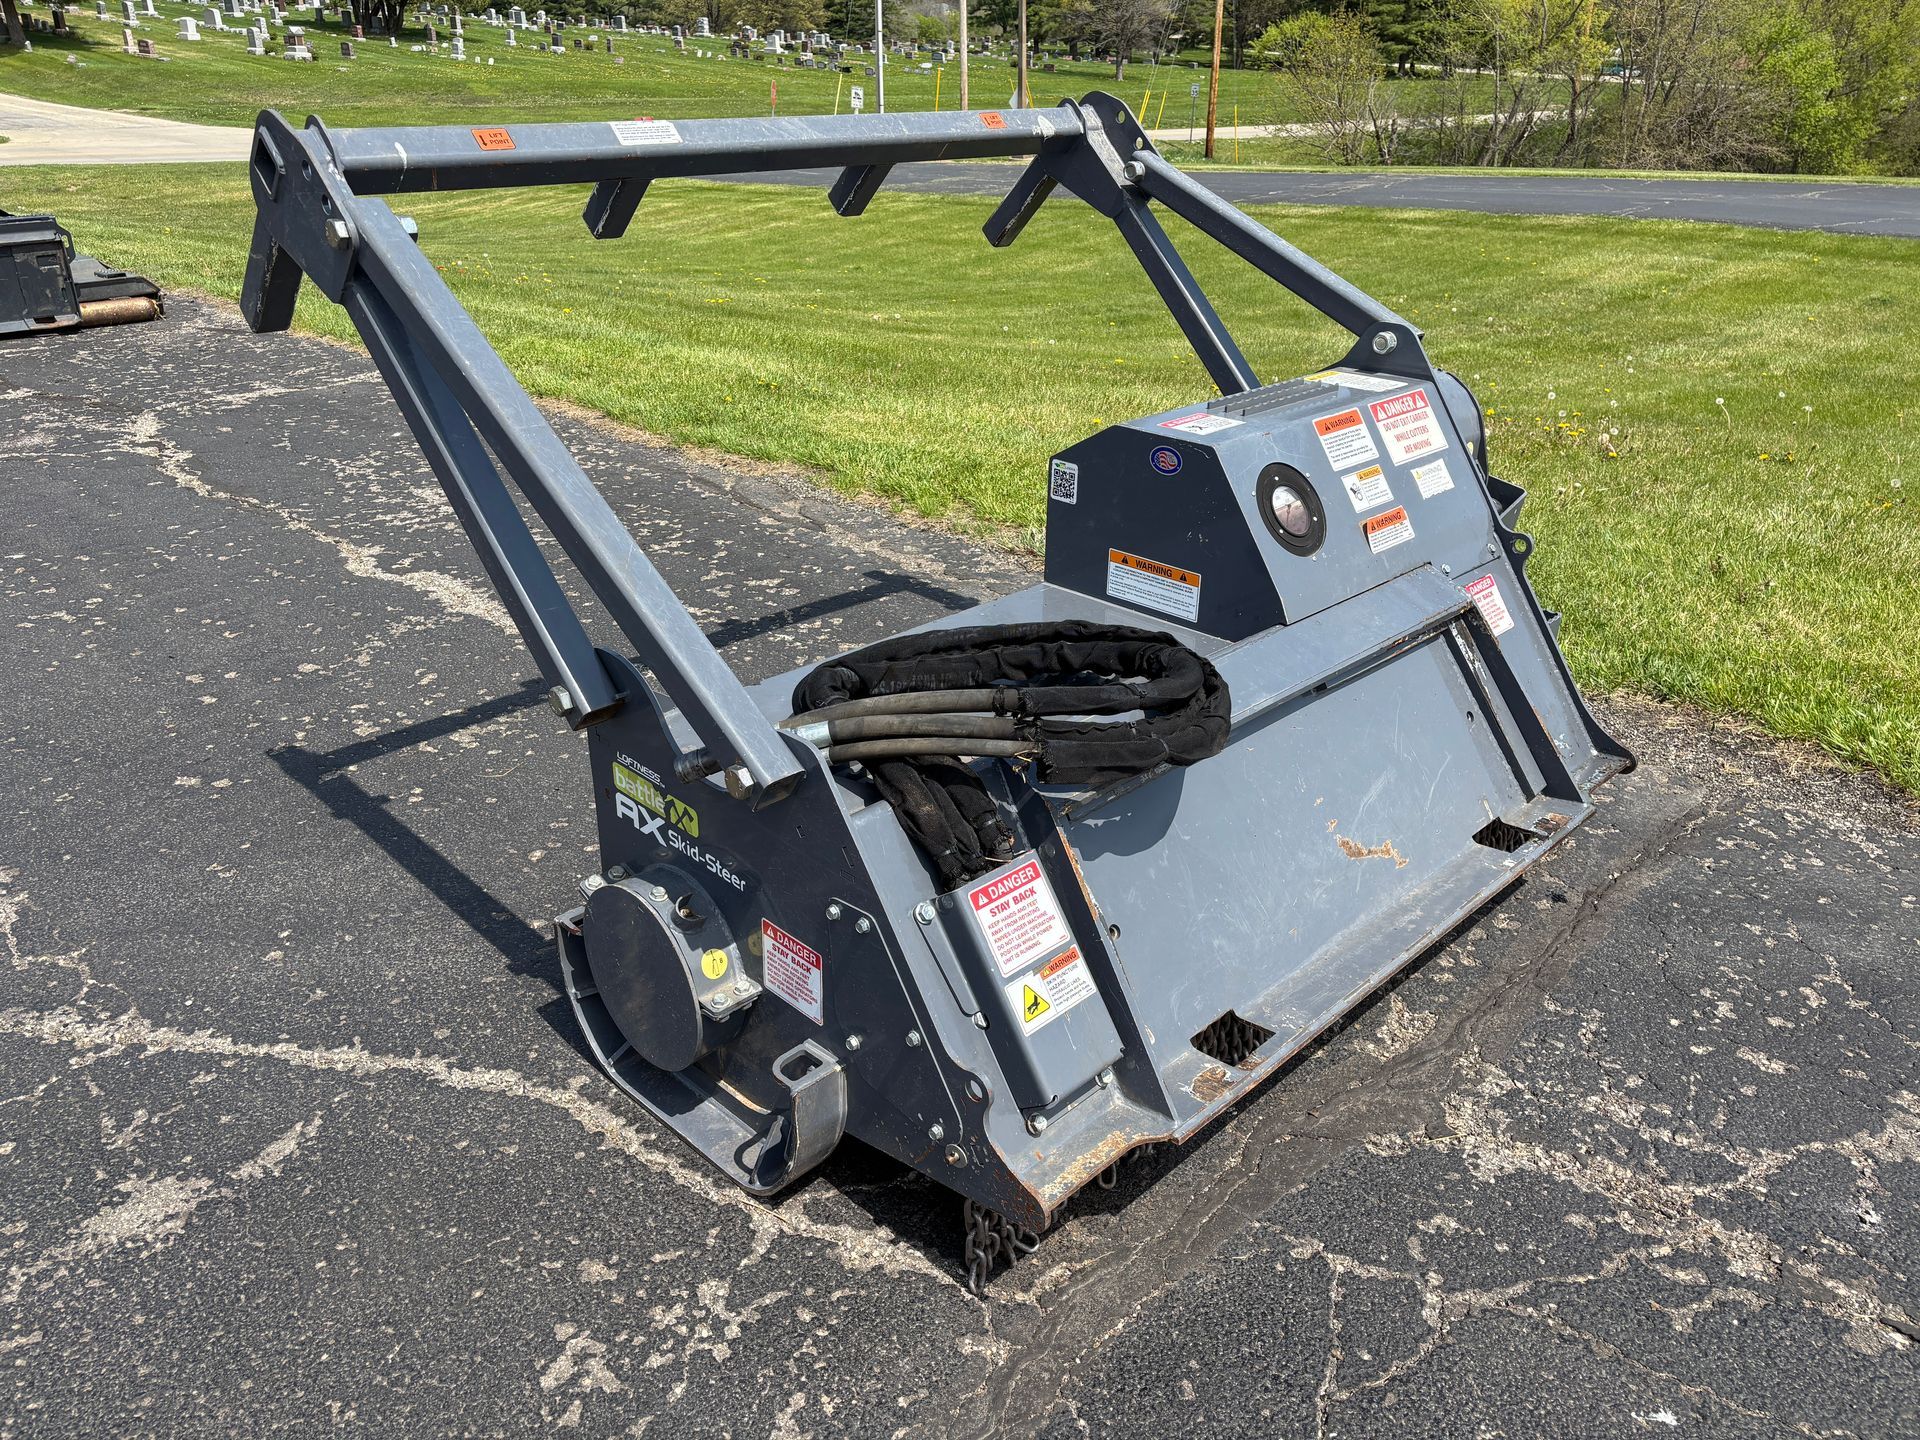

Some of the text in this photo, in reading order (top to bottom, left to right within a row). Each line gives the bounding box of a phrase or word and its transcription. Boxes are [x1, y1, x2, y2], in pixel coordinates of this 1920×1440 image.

[1383, 410, 1429, 432] DO NOT EXIT CARRIER
[1384, 396, 1416, 416] DANGER
[1329, 416, 1355, 428] WARNING
[1394, 425, 1429, 442] WHILE CUTTERS
[1404, 438, 1432, 454] ARE MOVING
[1376, 512, 1401, 527] WARNING
[1136, 560, 1172, 577] WARNING
[617, 751, 660, 783] LOFTNESS
[615, 768, 666, 813] battle
[616, 802, 667, 847] AX
[668, 830, 746, 891] Skid-Steer
[988, 867, 1035, 899] DANGER
[988, 920, 1000, 930] KEEP
[1001, 911, 1016, 923] HANDS
[1027, 900, 1038, 908] FEET
[989, 887, 1036, 918] STAY BACK
[991, 907, 1039, 937] AWAY FROM ROTATING
[994, 911, 1047, 944] KNIVES UNDER MACHINE
[1005, 938, 1014, 946] NOT
[1015, 930, 1028, 940] LEAVE
[1029, 915, 1055, 932] OPERATORS
[777, 931, 816, 965] DANGER
[1000, 943, 1021, 958] POSITION
[1022, 934, 1036, 945] WHILE
[1036, 925, 1052, 937] POWER
[1004, 956, 1014, 965] UNIT
[1020, 940, 1041, 955] RUNNING.
[772, 943, 811, 975] STAY BACK
[1049, 951, 1076, 972] WARNING
[1046, 963, 1078, 986] SKIN PUNCTURE
[1049, 978, 1066, 991] HAZARD
